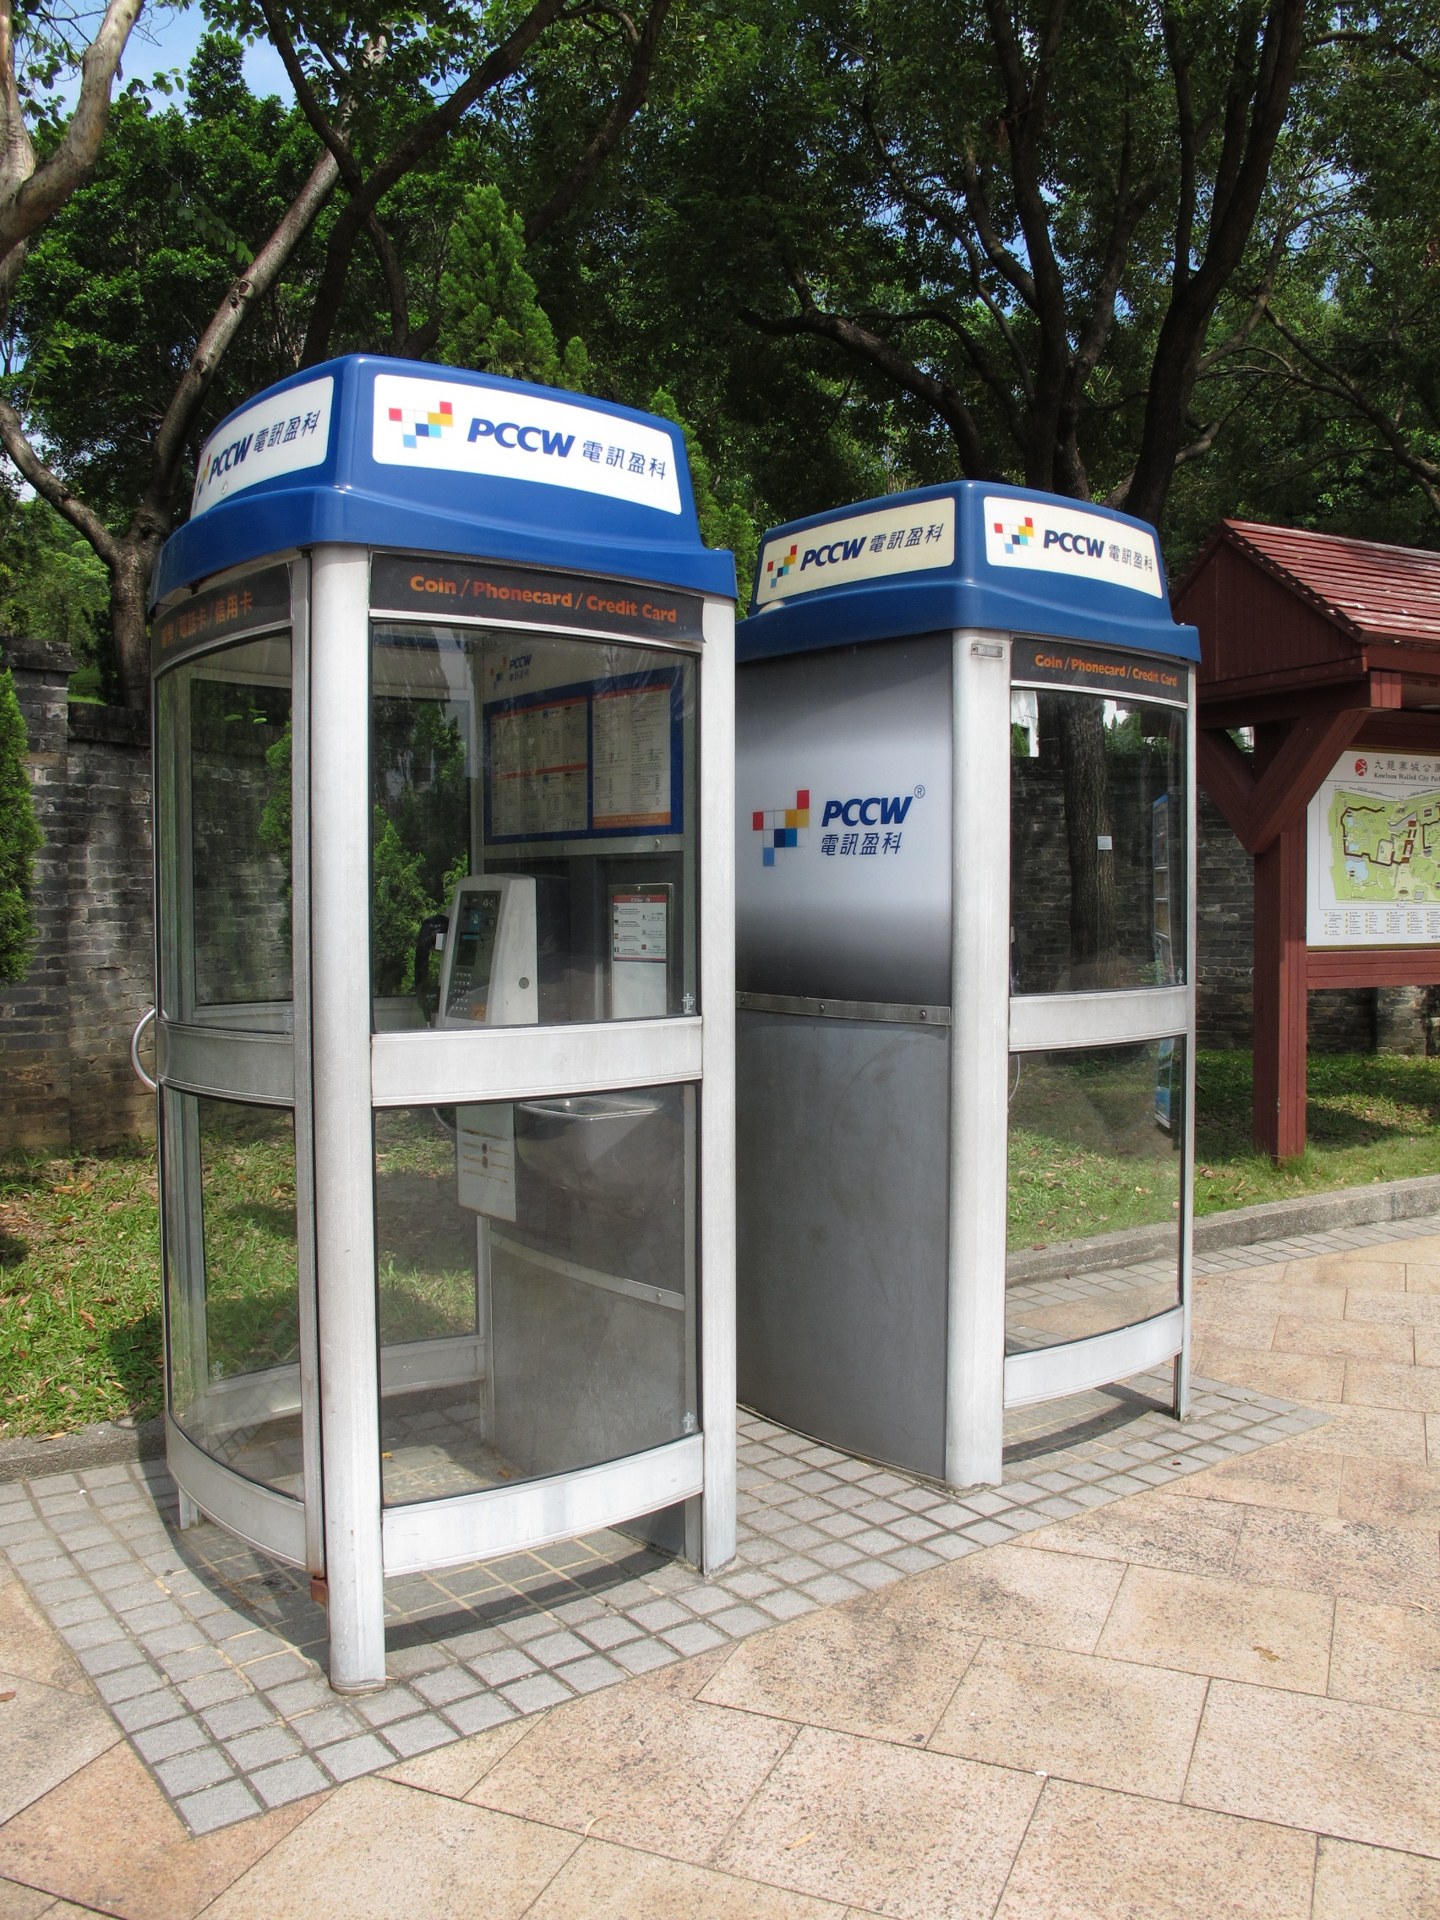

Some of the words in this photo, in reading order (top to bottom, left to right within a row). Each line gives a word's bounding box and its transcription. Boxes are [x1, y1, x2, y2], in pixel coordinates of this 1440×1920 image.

[208, 433, 254, 485] PCCW
[254, 409, 321, 453] 電訊盈科
[466, 417, 576, 458] PCCW
[582, 440, 666, 480] 電訊盈科
[800, 536, 867, 571] PCCW
[869, 523, 944, 553] 電訊盈科
[1043, 529, 1105, 559] PCCW
[1108, 544, 1153, 573] 電訊盈科
[409, 575, 456, 595] Coin
[472, 581, 572, 608] Phonecard
[586, 595, 638, 617] Credit
[642, 604, 677, 623] Card
[1034, 654, 1062, 669] Coin
[1071, 658, 1125, 677] Phonecard
[1132, 668, 1159, 683] Credit
[1160, 673, 1178, 687] Card
[821, 796, 913, 827] PCCW
[821, 832, 902, 856] 電訊盈科
